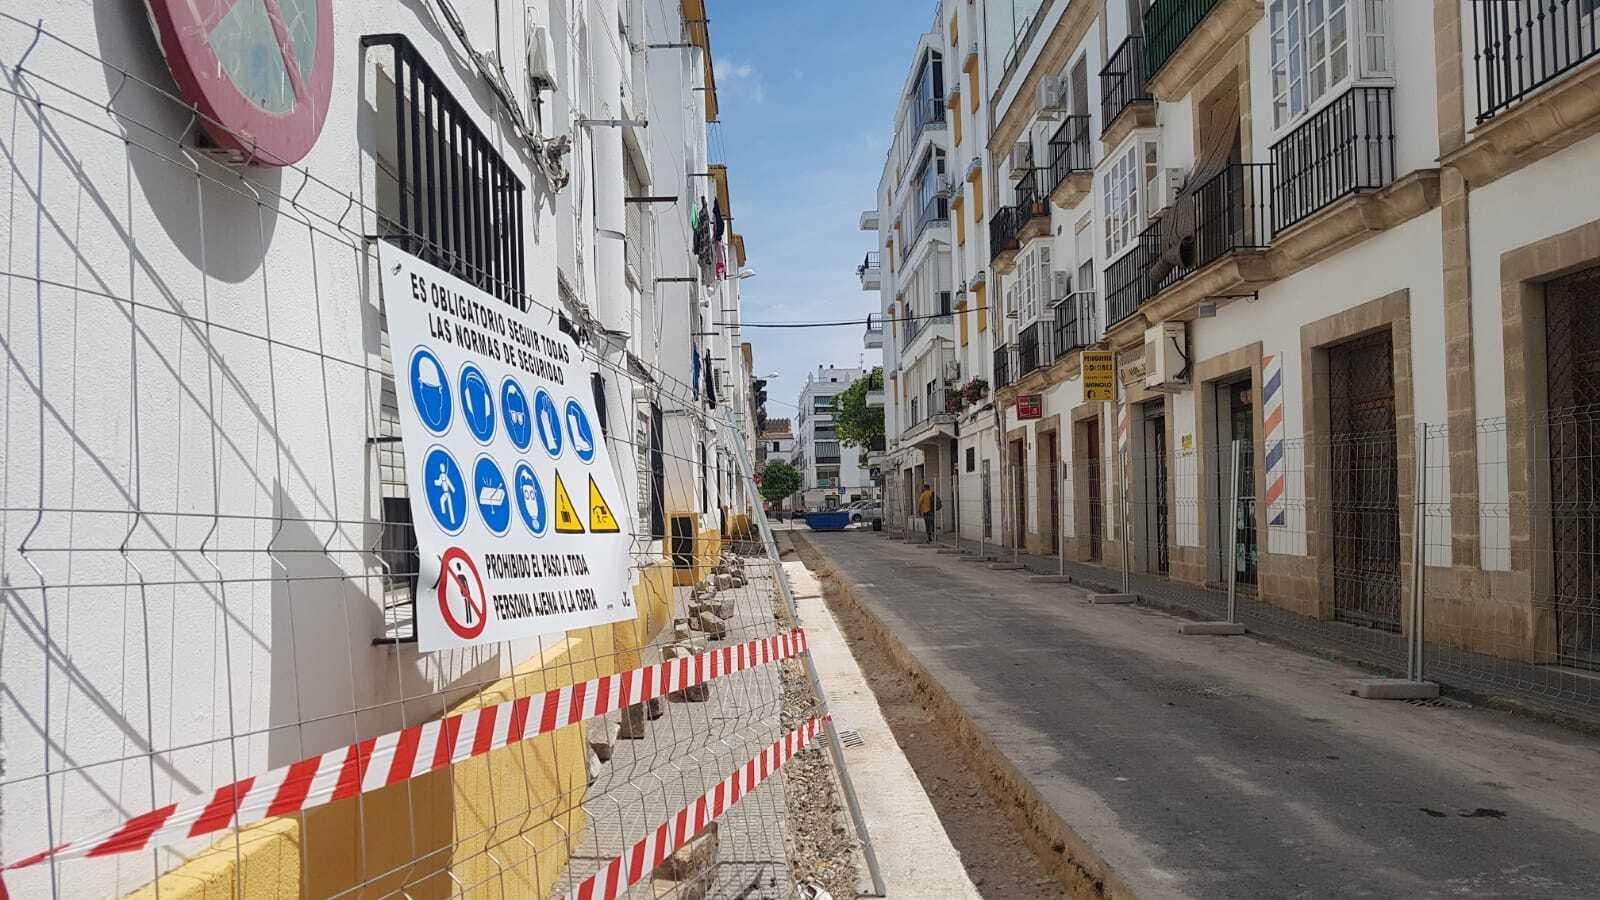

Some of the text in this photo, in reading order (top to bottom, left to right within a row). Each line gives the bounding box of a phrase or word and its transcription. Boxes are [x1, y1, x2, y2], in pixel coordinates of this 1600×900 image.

[410, 272, 570, 364] ES OBLIGATORIO SEGUIR TODAS
[428, 312, 564, 386] LAS NORMAS DE SEGURIDAD
[485, 553, 590, 579] PROHIBIDO EL PASO A TODA
[493, 593, 534, 621] PERSONA
[534, 590, 559, 617] AJENA
[559, 590, 566, 614] A
[566, 589, 576, 613] LA
[576, 588, 598, 612] OBRA
